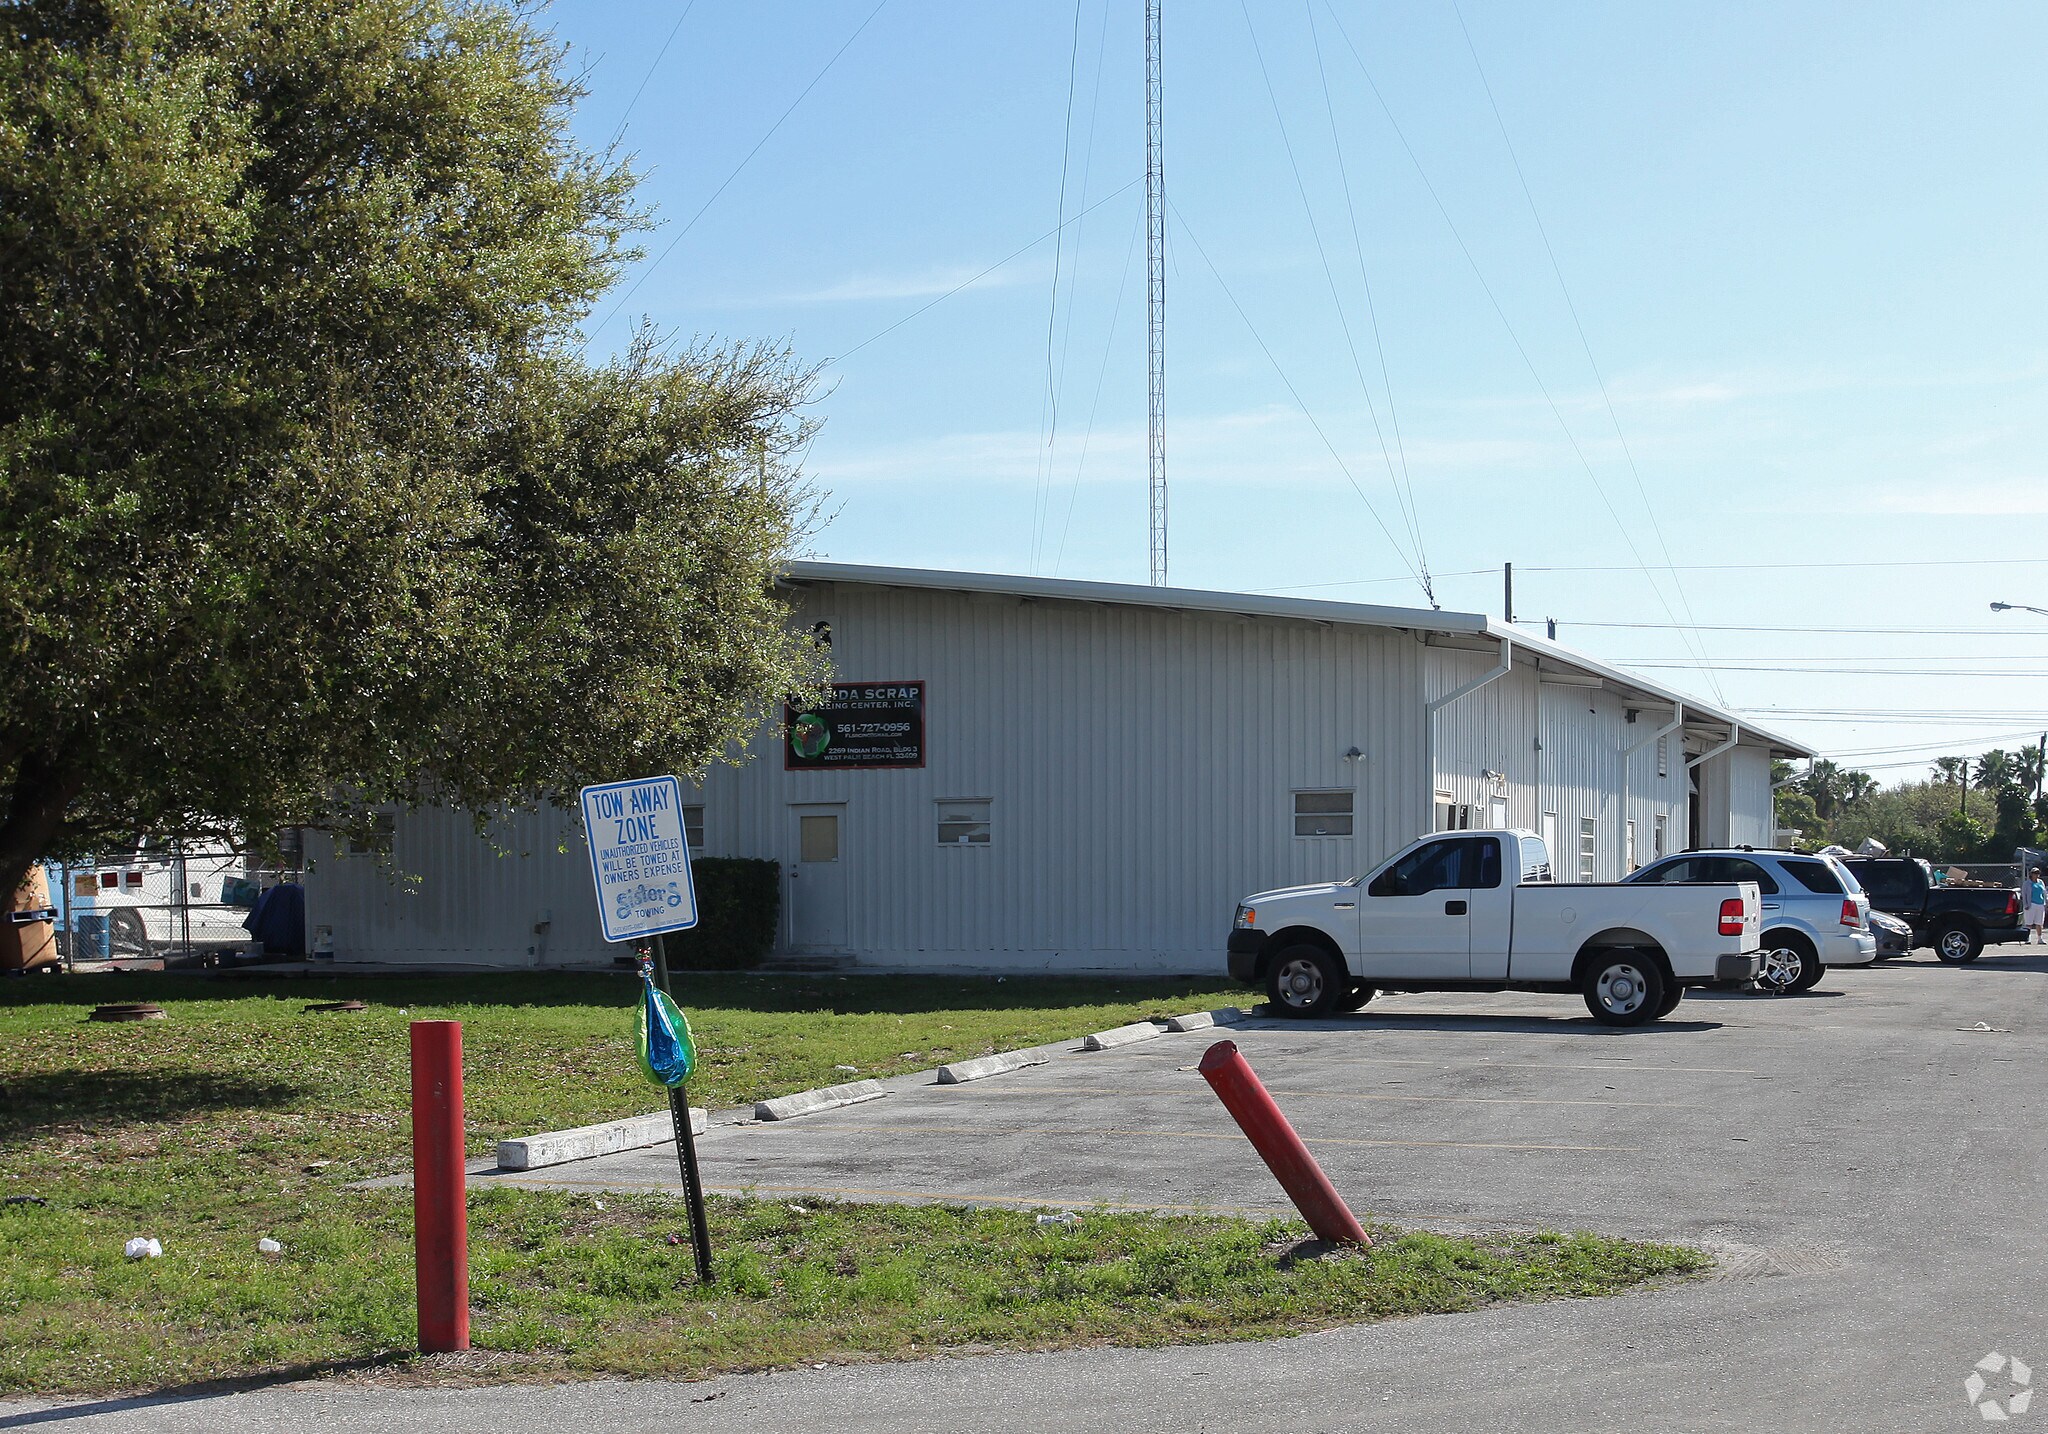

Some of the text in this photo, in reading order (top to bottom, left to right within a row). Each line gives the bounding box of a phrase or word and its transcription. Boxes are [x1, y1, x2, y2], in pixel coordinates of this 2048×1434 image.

[850, 701, 891, 709] CENTER,
[894, 700, 914, 708] INC.
[864, 687, 919, 700] SCRAP
[837, 722, 910, 733] 561-727-0956
[592, 784, 668, 820] TOW AWAY
[614, 814, 660, 845] ZONE
[600, 838, 679, 860] UNAUTHORIZED VEHICLES
[602, 850, 681, 872] WILL BE TOWED AT
[604, 862, 683, 885] OWNERS EXPENSE
[634, 905, 665, 918] TOWING
